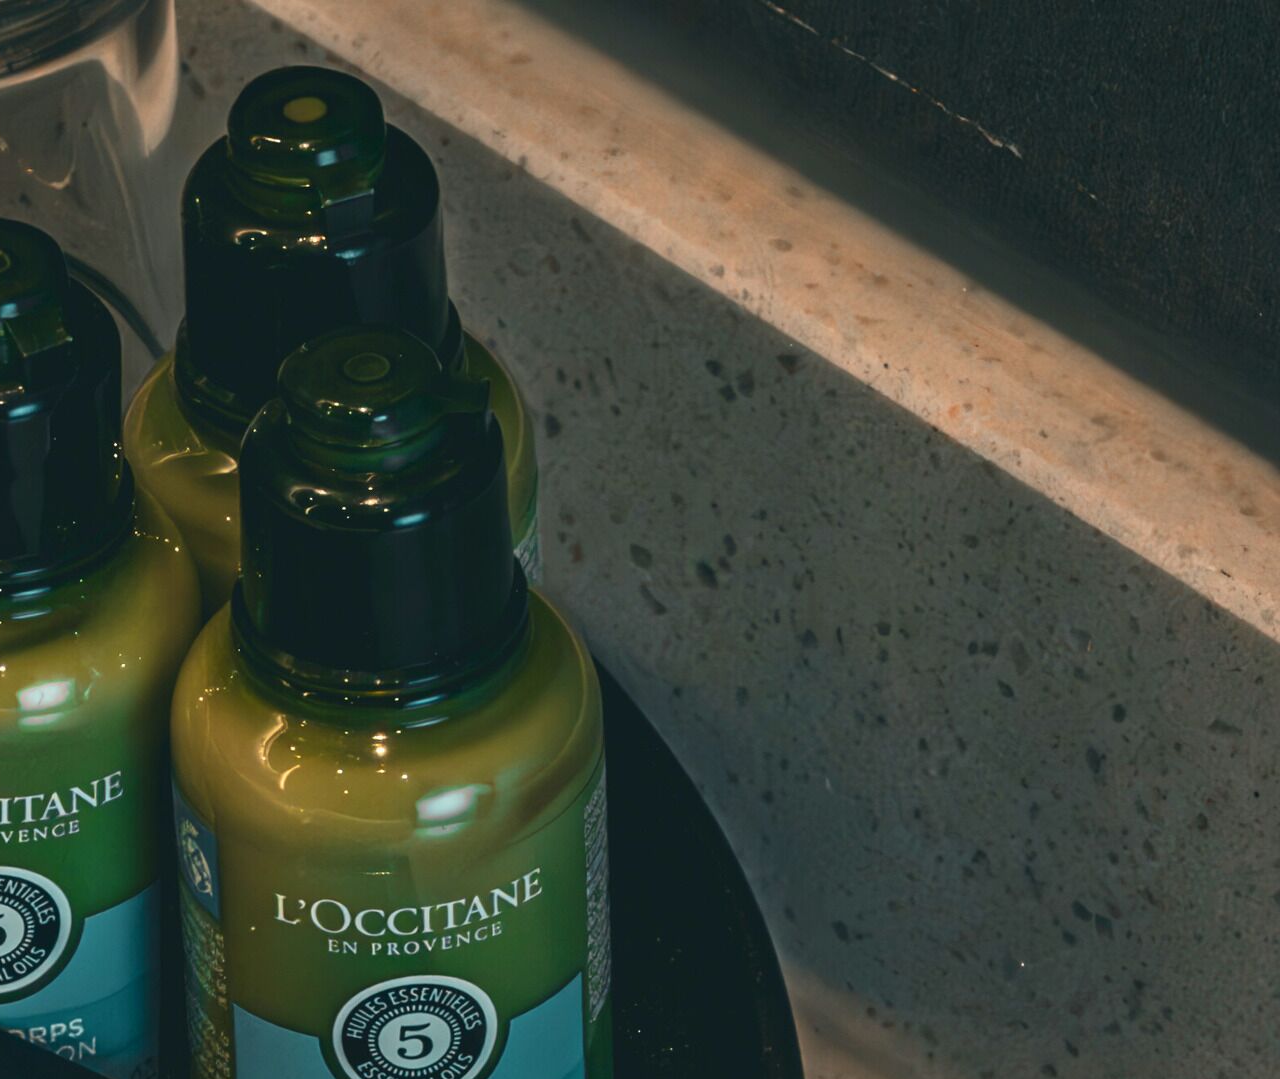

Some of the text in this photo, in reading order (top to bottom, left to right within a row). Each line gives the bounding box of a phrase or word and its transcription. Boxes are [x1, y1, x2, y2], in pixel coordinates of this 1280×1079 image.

[328, 921, 503, 956] EN PROVENCE
[13, 946, 46, 974] OILS
[346, 987, 482, 1039] HUILES ESSENTIELLES
[397, 1022, 434, 1060] 5
